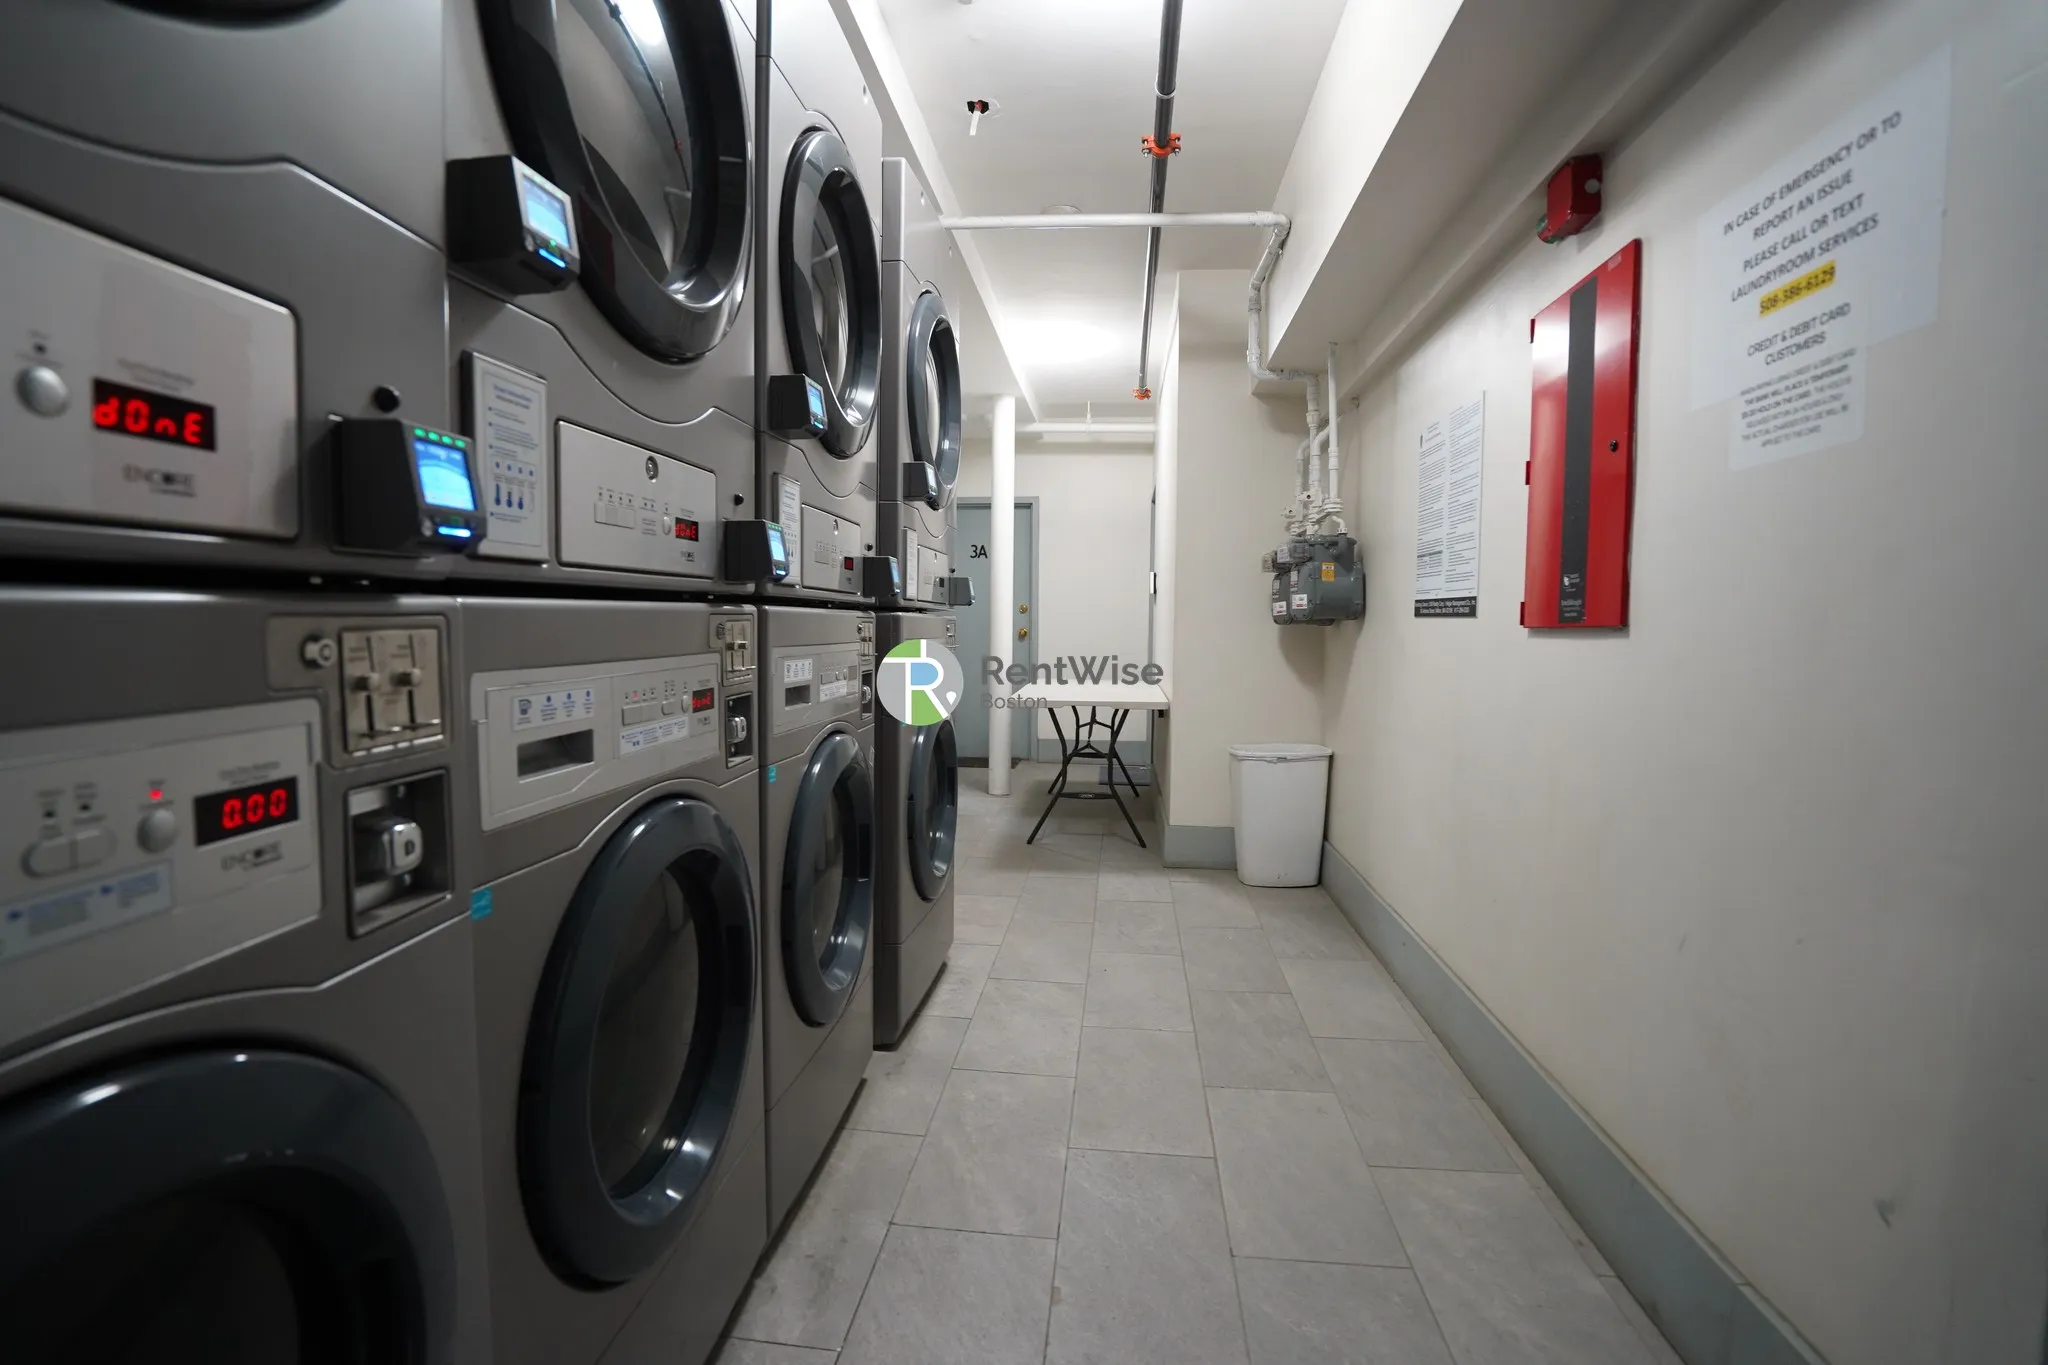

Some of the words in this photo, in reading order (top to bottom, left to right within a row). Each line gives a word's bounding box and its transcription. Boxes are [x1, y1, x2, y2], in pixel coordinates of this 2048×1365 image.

[1724, 221, 1734, 236] IN
[1736, 203, 1760, 228] CASE
[1762, 192, 1777, 210] OF
[1779, 142, 1853, 200] EMERGENCY
[1856, 126, 1877, 150] OR
[1881, 111, 1901, 134] TO
[1753, 205, 1795, 240] REPORT
[1796, 193, 1815, 214] AN
[1817, 169, 1853, 201] ISSUE
[1731, 247, 1815, 302] LAUNDRYROOM
[1818, 213, 1880, 257] SERVICES
[1743, 241, 1779, 272] PLEASE
[1781, 227, 1808, 250] CALL
[1810, 212, 1829, 234] OR
[1832, 193, 1865, 222] TEXT
[1747, 333, 1779, 357] CREDIT
[1789, 316, 1818, 339] DEBIT
[1820, 302, 1851, 325] CARD
[1765, 331, 1826, 366] CUSTOMERS
[970, 544, 988, 559] 3A
